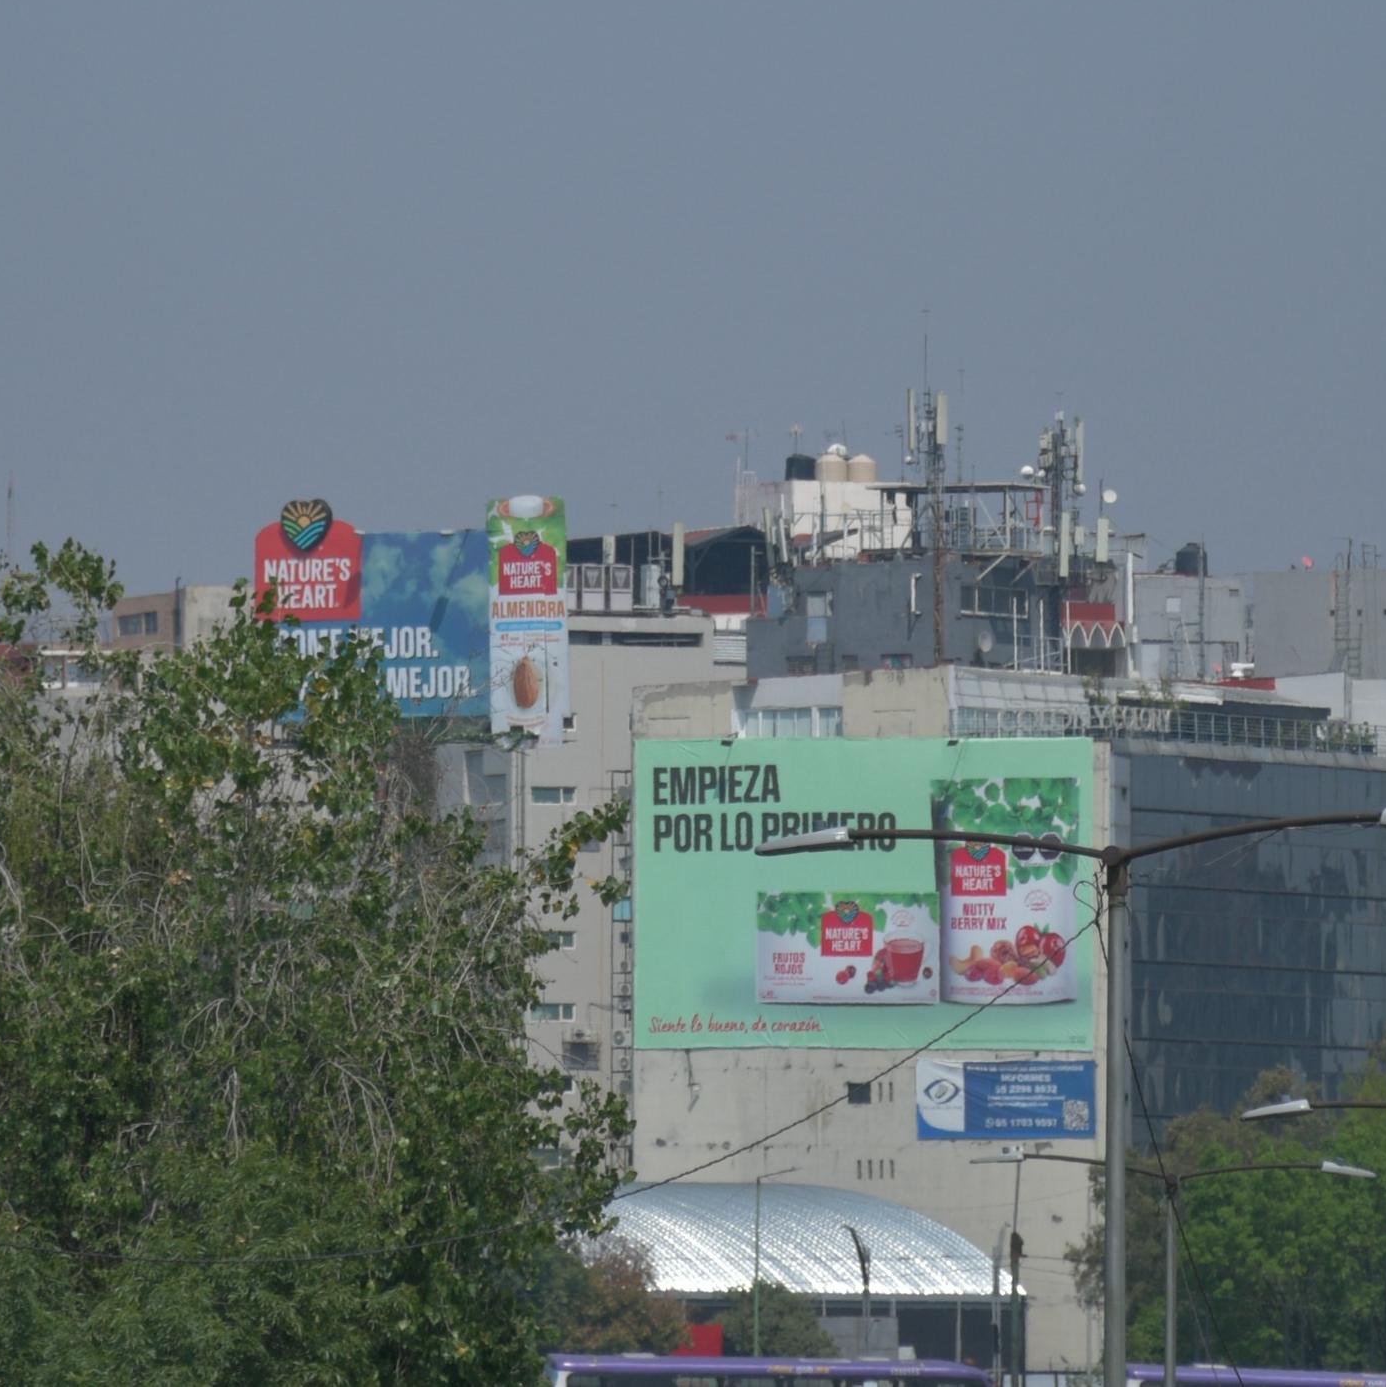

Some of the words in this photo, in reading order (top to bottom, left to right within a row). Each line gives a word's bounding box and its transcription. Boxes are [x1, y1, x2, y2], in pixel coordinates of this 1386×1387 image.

[263, 557, 351, 583] NATURE'S
[502, 561, 552, 576] NATURE'S
[509, 574, 542, 589] HEART
[277, 583, 337, 610] HEART
[386, 666, 477, 699] MEJOR.
[652, 764, 781, 805] EMPIEZA
[653, 813, 713, 853] POR
[720, 811, 754, 852] LO
[955, 864, 1002, 879] NATURE'S
[961, 878, 995, 892] HEART
[962, 903, 995, 916] NUTTY
[951, 916, 984, 930] BERRY
[986, 916, 1008, 930] MIX
[825, 927, 869, 941] NATURE'S
[831, 939, 862, 952] HEART
[773, 952, 806, 963] FRUTOS
[774, 963, 803, 975] ROJOS
[648, 1015, 686, 1033] Siente
[690, 1013, 703, 1033] lo
[752, 1014, 767, 1032] de
